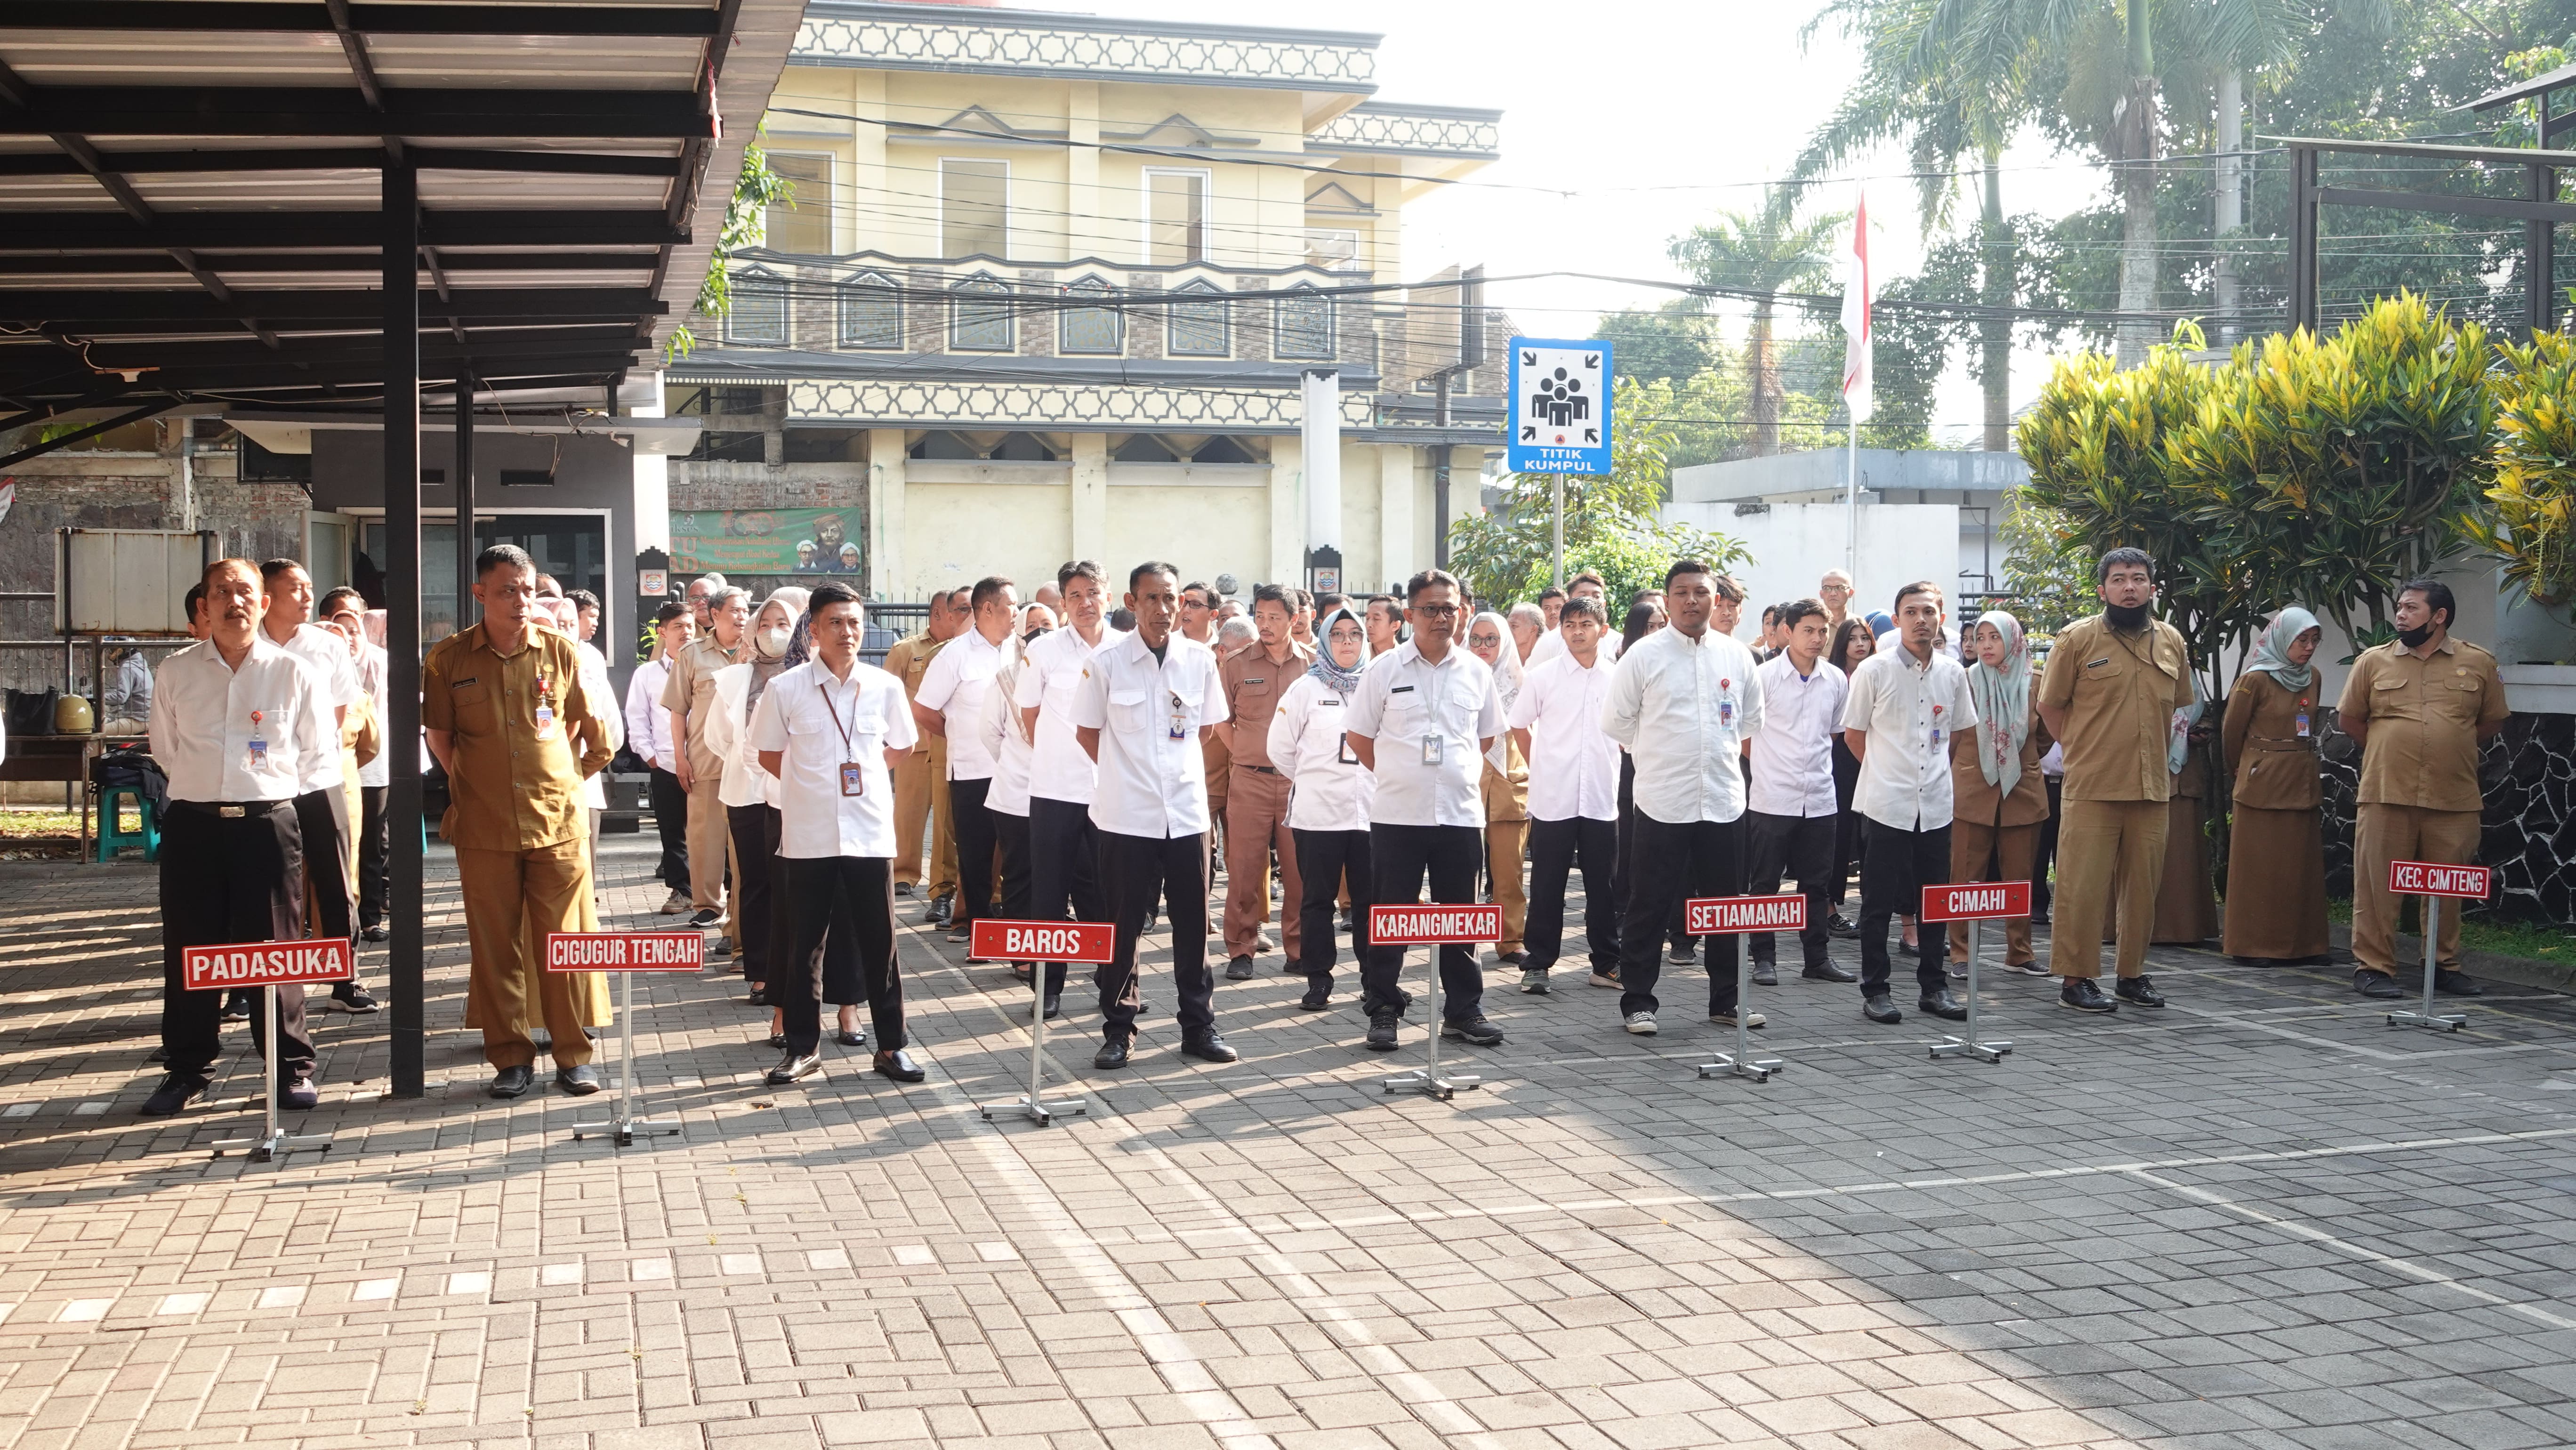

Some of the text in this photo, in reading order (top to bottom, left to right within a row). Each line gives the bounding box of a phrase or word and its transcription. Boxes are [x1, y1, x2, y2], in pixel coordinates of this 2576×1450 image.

[1525, 460, 1595, 471] KUMPUL
[1540, 448, 1582, 459] TITIK
[670, 537, 698, 554] TU
[669, 556, 700, 573] AD
[700, 561, 791, 573] Menuju Kebangkitan Baru
[2396, 866, 2483, 893] KEC. CIMTENG
[1948, 889, 2005, 913] CIMAHI
[1376, 912, 1496, 937] KARANGMEKAR
[1692, 902, 1801, 929] SETIAMANAH
[552, 939, 698, 965] CIGUGUR TENGAH
[1006, 928, 1081, 954] BAROS
[193, 947, 343, 981] PADASUKA
